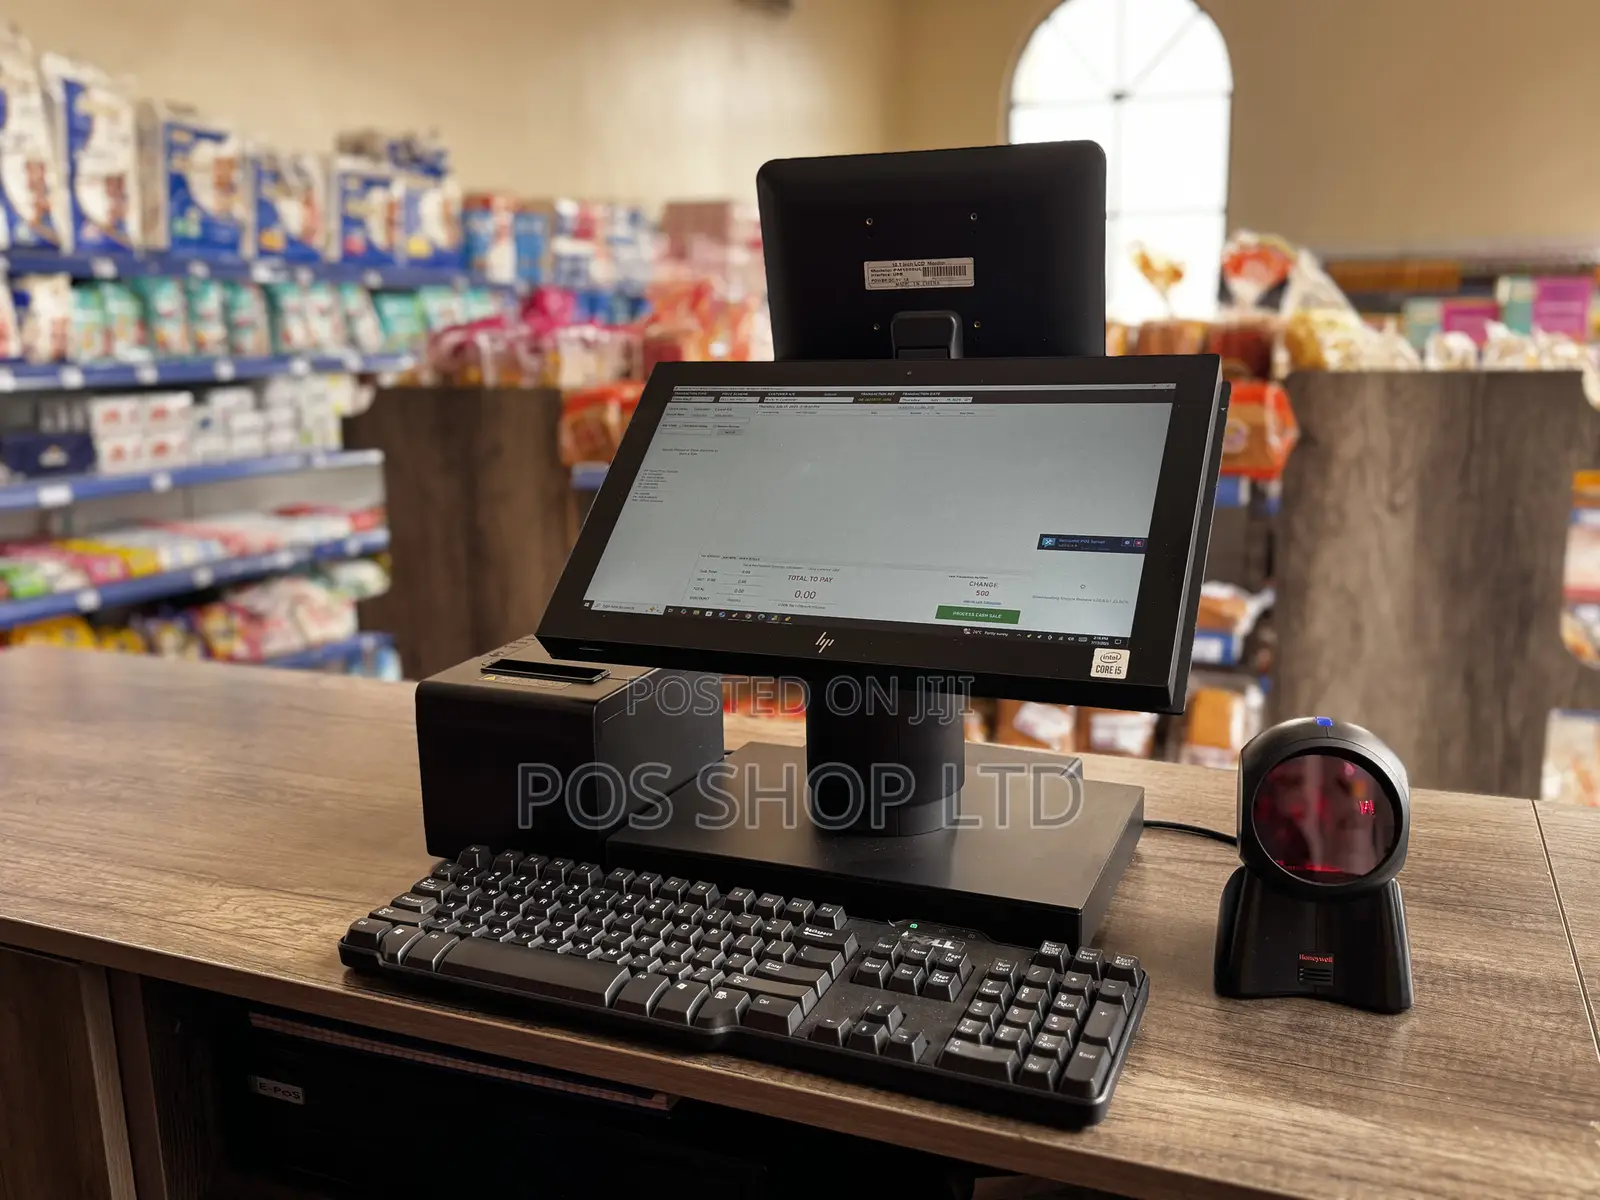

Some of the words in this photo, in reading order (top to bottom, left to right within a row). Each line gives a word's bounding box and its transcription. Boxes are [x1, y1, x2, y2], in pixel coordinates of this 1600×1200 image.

[788, 574, 808, 582] TOTAL
[819, 575, 835, 584] PAY
[794, 589, 817, 600] 0.00
[975, 589, 990, 597] 500
[1095, 664, 1114, 675] CORE
[1114, 665, 1123, 675] i5
[1298, 953, 1333, 964] Honeywell
[982, 987, 1000, 995] Home
[1079, 1051, 1097, 1060] Enter
